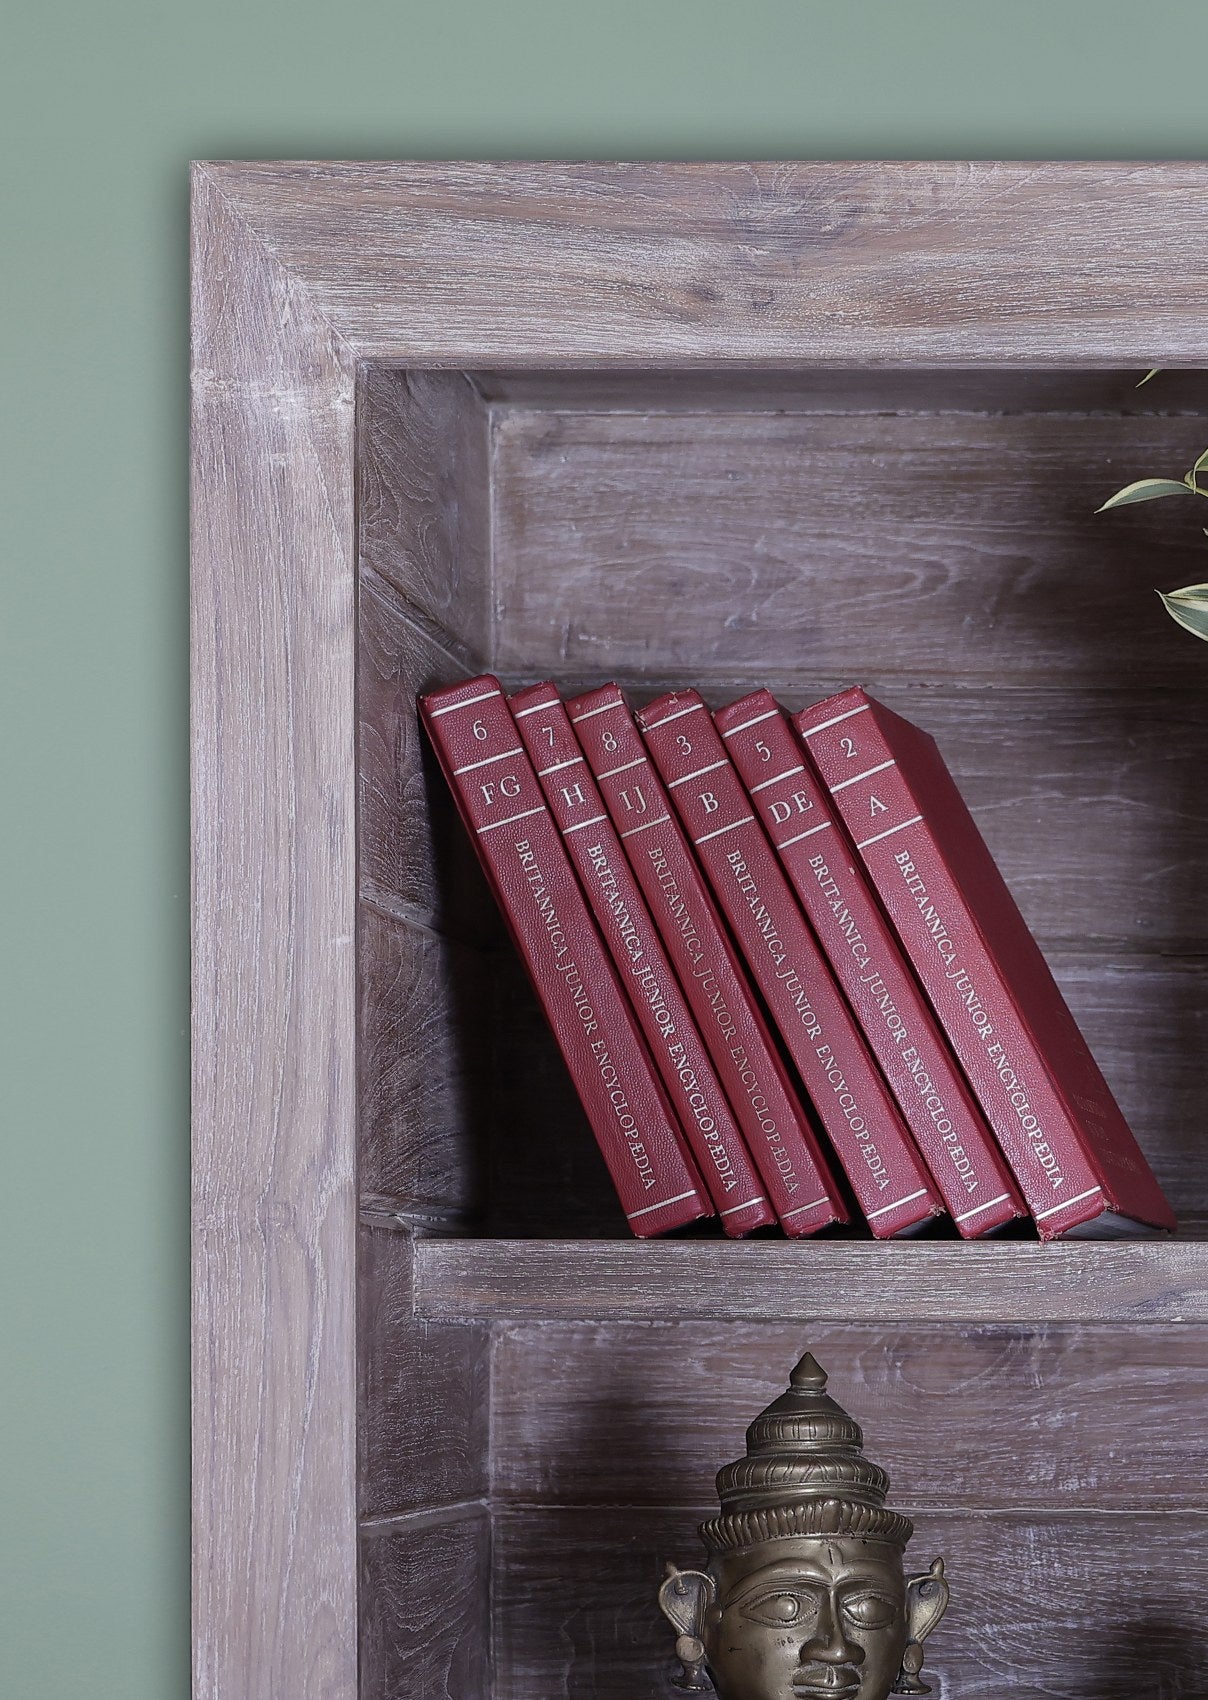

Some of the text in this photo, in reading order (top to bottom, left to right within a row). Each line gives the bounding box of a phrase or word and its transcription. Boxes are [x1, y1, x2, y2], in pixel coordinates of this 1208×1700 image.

[473, 721, 487, 741] 6
[542, 728, 556, 748] 7
[603, 732, 617, 752] 8
[677, 736, 693, 756] 3
[756, 741, 771, 762] 5
[840, 737, 857, 758] 2
[480, 775, 522, 805] FG
[562, 784, 586, 807] H
[619, 784, 647, 813] IJ
[698, 791, 719, 814] B
[768, 790, 813, 824] DE
[868, 795, 889, 817] A
[515, 839, 568, 959] BRITANNICA
[555, 962, 598, 1035] JUNIOR
[588, 842, 643, 963] BRITANNICA
[633, 964, 675, 1037] JUNIOR
[648, 848, 703, 966] BRITANNICA
[692, 970, 734, 1043] JUNIOR
[726, 851, 786, 969] BRITANNICA
[776, 971, 823, 1043] JUNIOR
[809, 854, 869, 970] BRITANNICA
[861, 972, 908, 1046] JUNIOR
[894, 849, 957, 969] BRITANNICA
[946, 970, 994, 1041] JUNIOR
